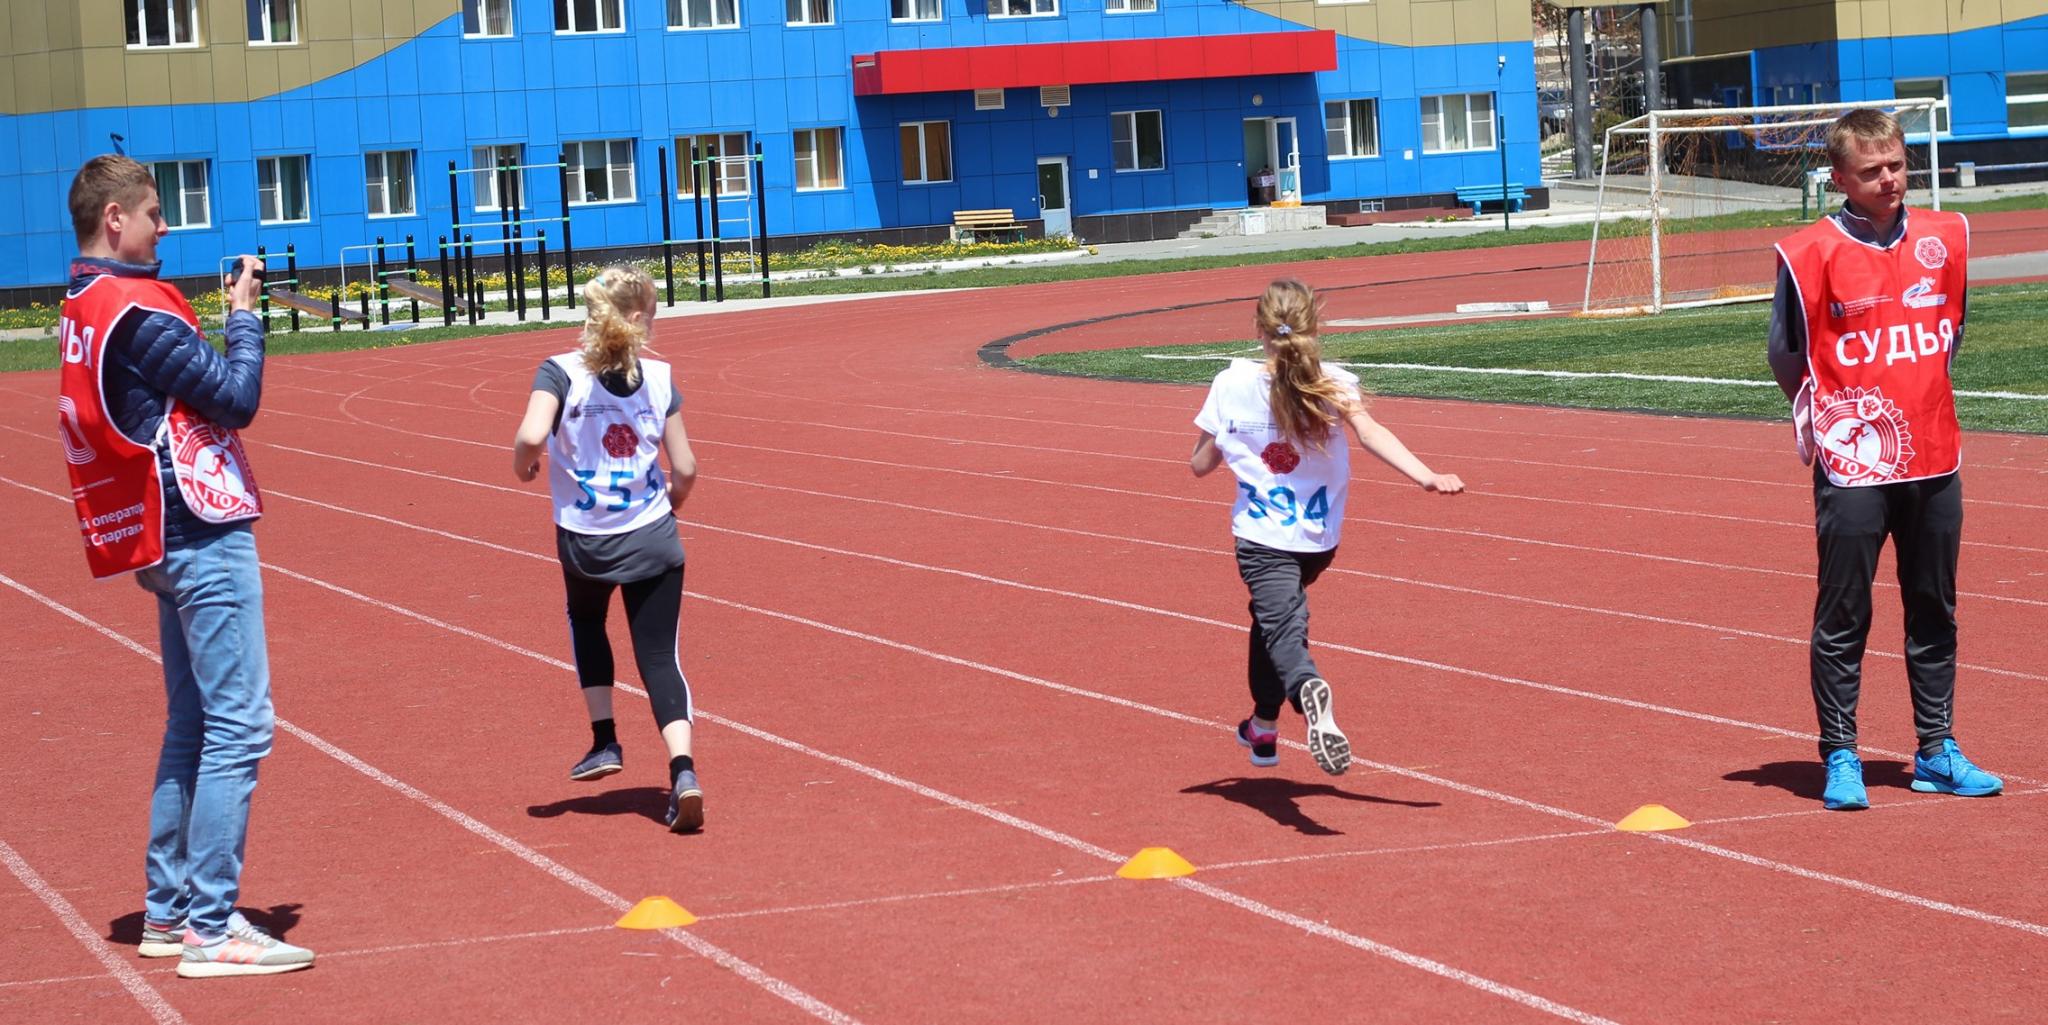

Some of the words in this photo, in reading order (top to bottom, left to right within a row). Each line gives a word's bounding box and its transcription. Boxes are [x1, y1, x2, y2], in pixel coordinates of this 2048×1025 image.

[1836, 318, 1953, 366] СУДЬЯ
[1829, 453, 1860, 475] ГТО
[203, 489, 233, 508] ГТО
[1238, 483, 1329, 528] 394
